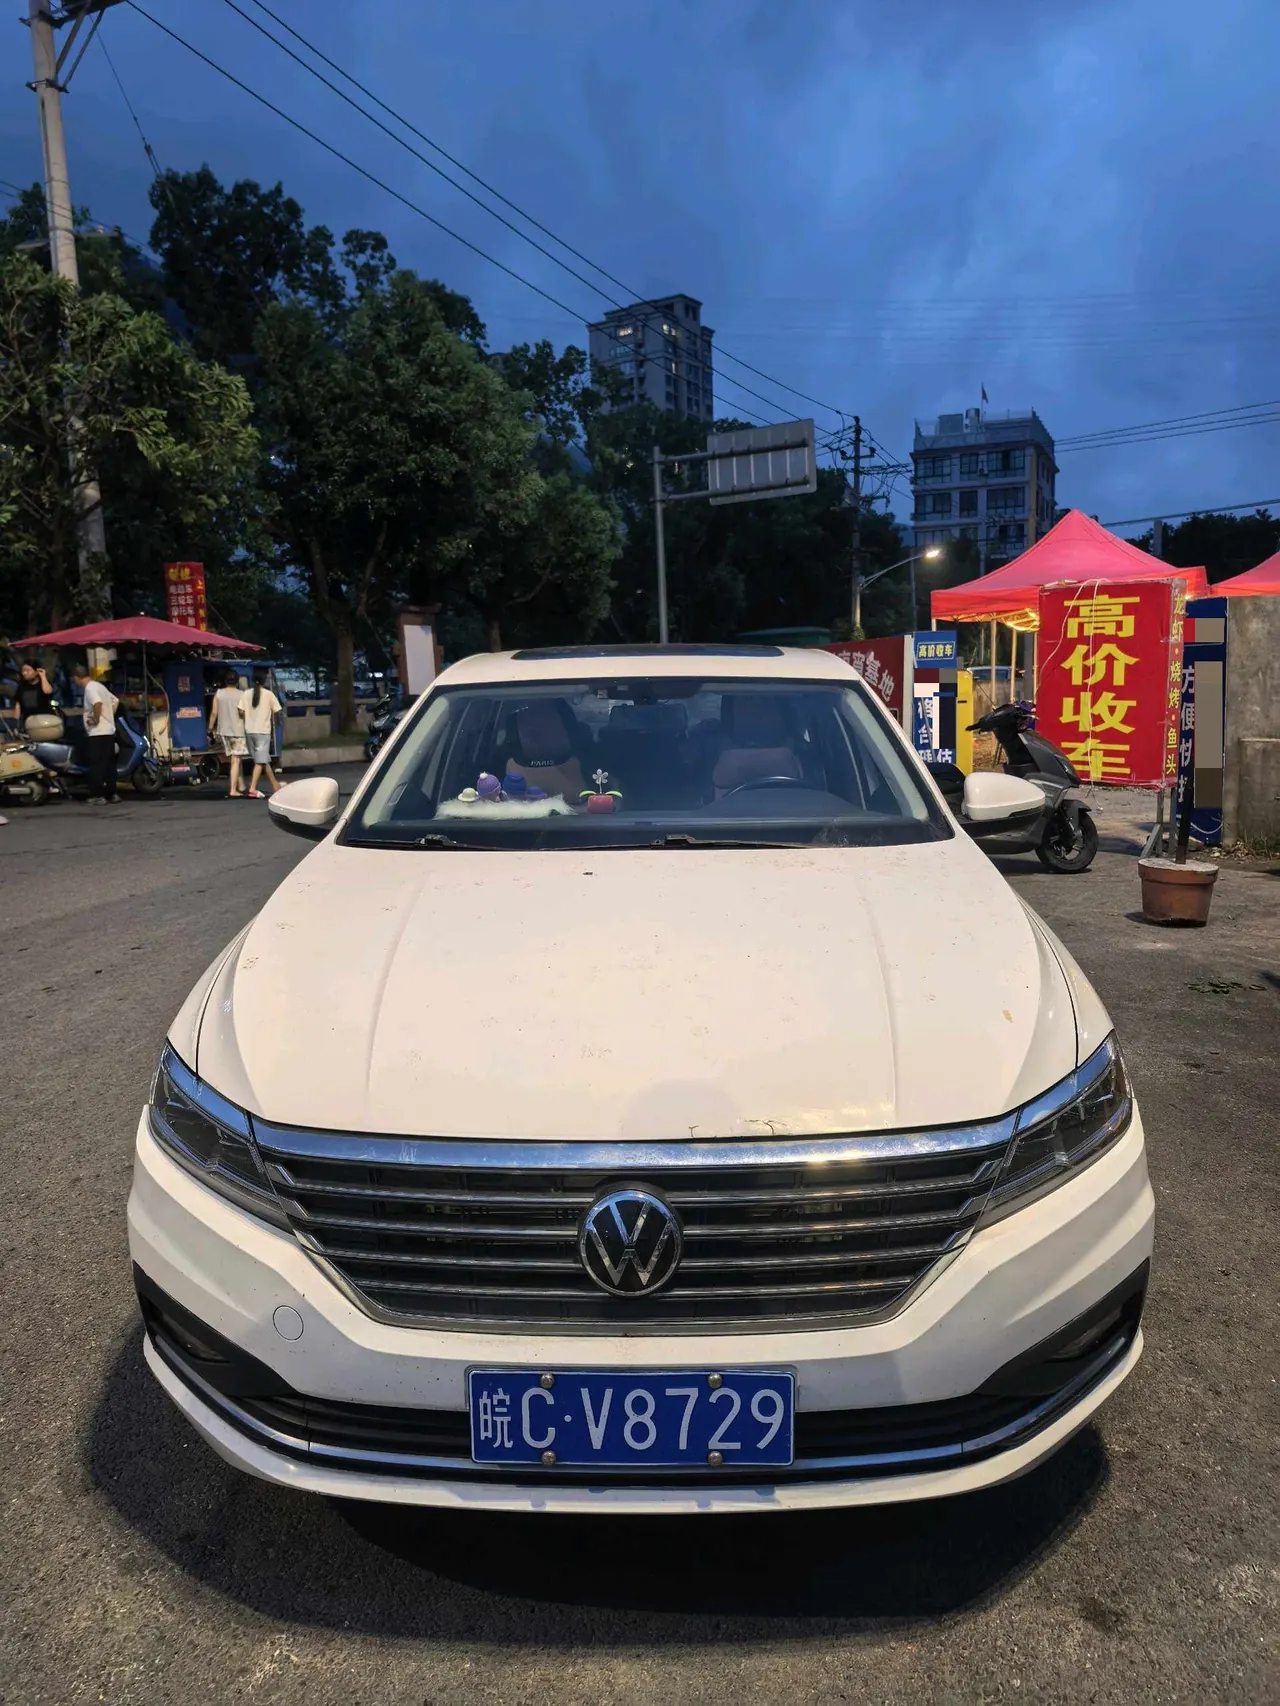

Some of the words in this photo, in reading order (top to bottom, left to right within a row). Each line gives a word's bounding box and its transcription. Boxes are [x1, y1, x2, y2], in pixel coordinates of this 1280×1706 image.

[918, 643, 953, 658] 高价收车
[1059, 594, 1141, 781] 高价收车
[478, 1387, 785, 1450] 皖C·V8729
